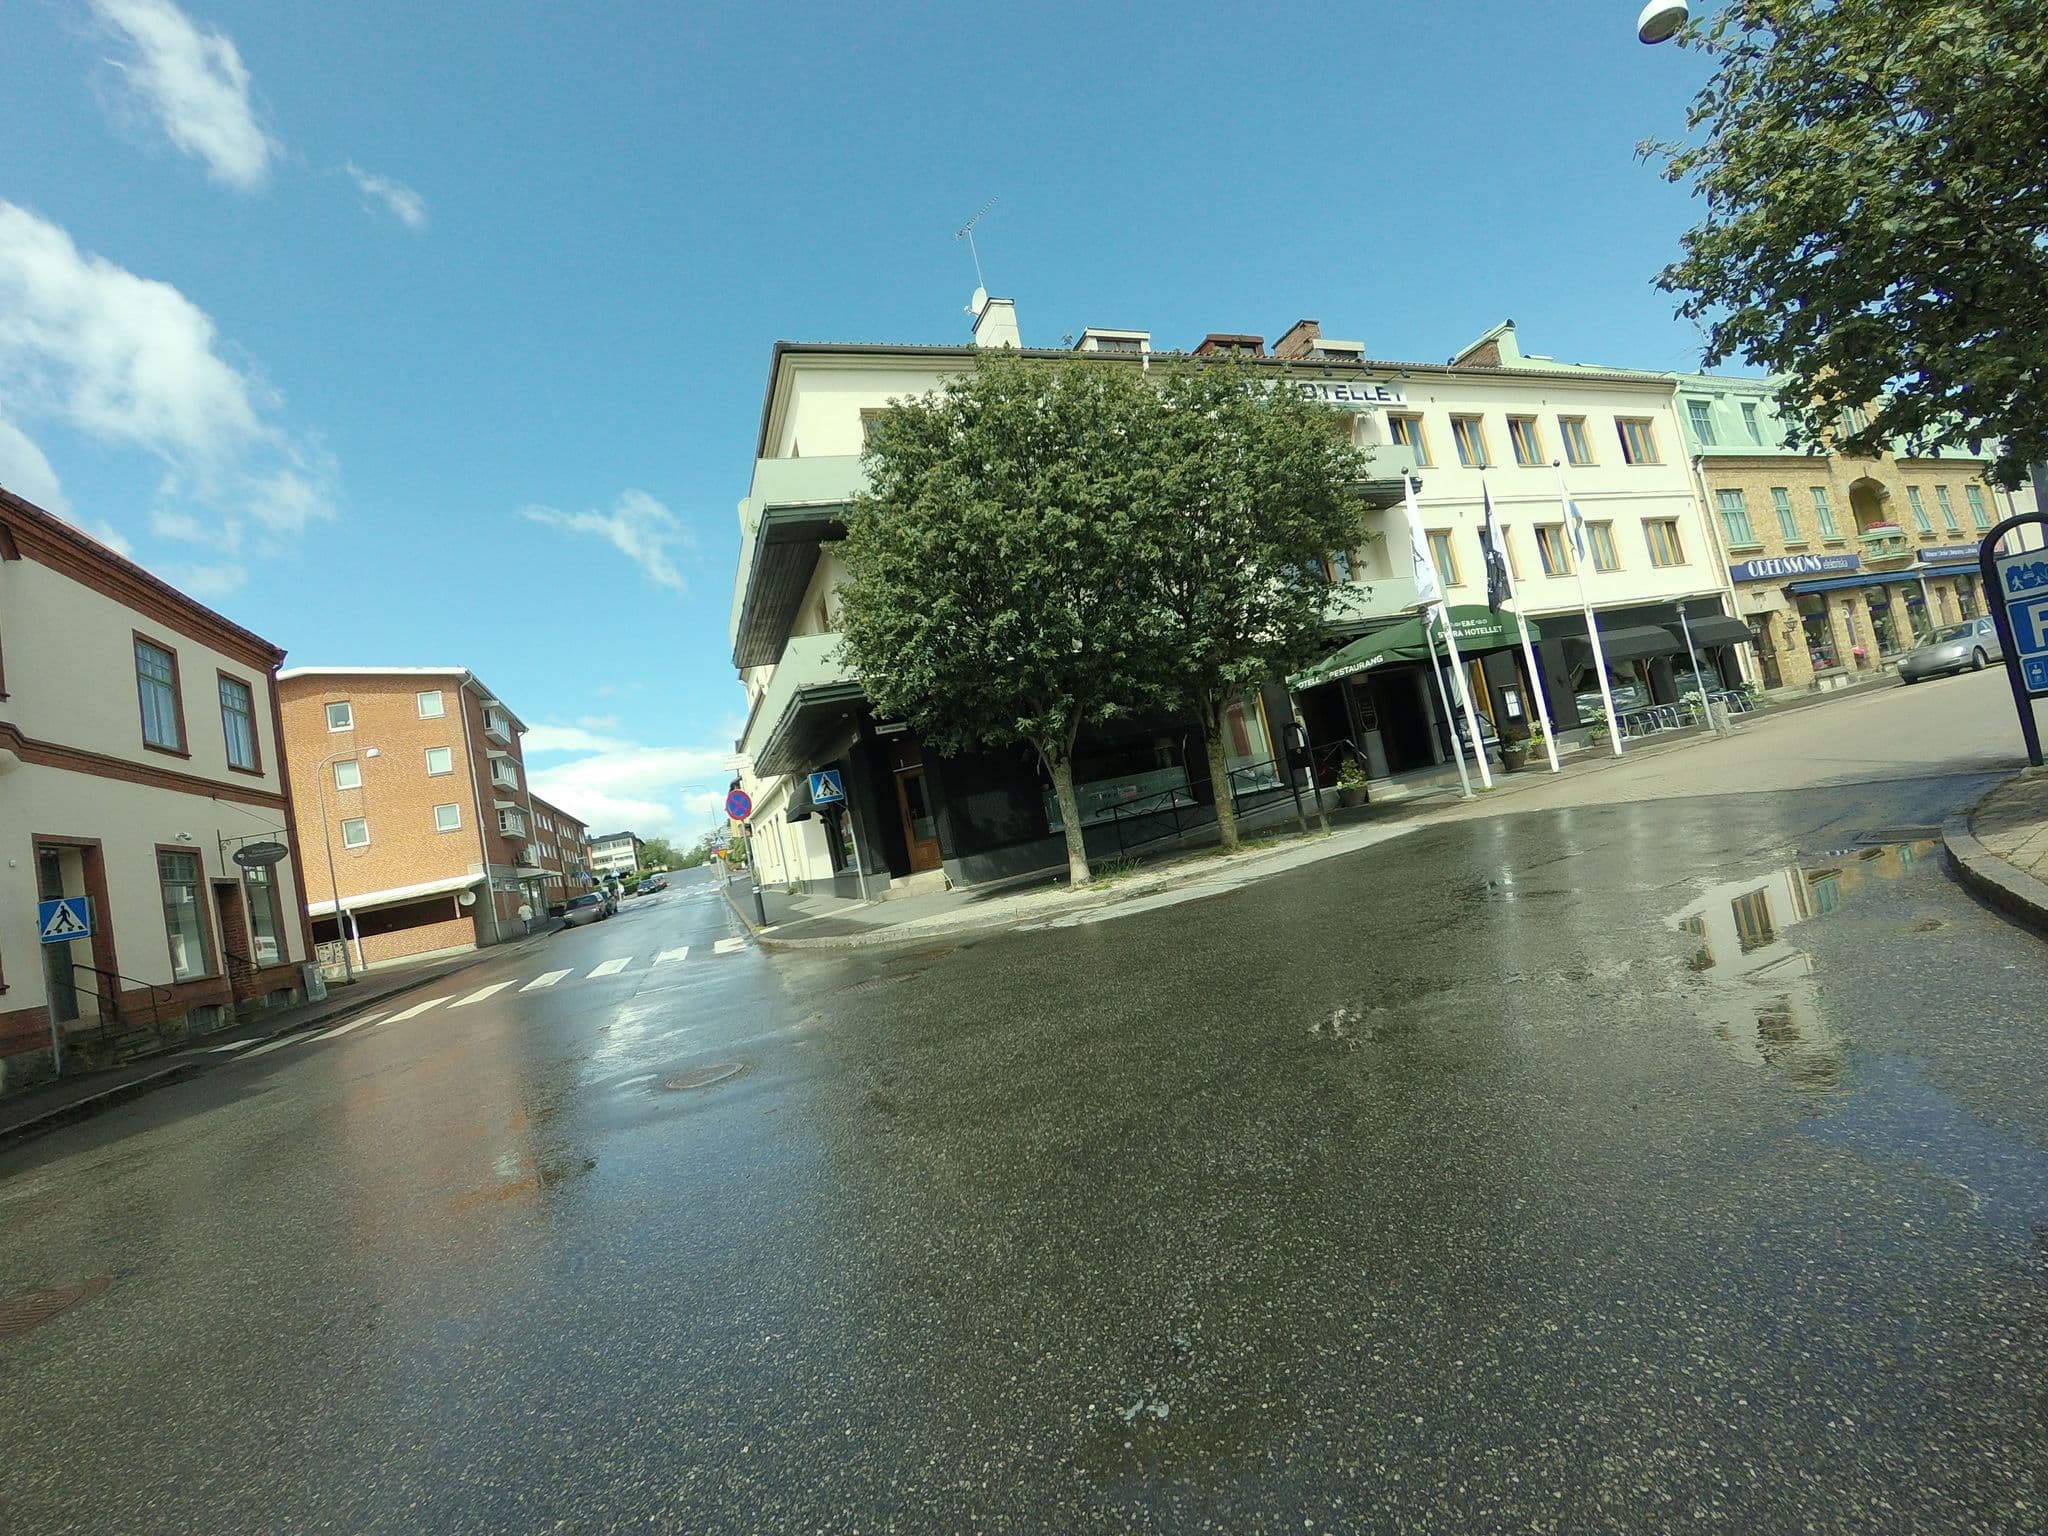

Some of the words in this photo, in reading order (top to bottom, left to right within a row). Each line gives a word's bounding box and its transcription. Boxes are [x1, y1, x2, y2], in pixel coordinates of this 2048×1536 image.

[1297, 382, 1403, 402] OTELLET
[1747, 555, 1822, 577] OREDSSONS
[1437, 630, 1464, 639] SRA
[1464, 625, 1503, 636] HOTELLET
[1296, 675, 1322, 690] OTELL
